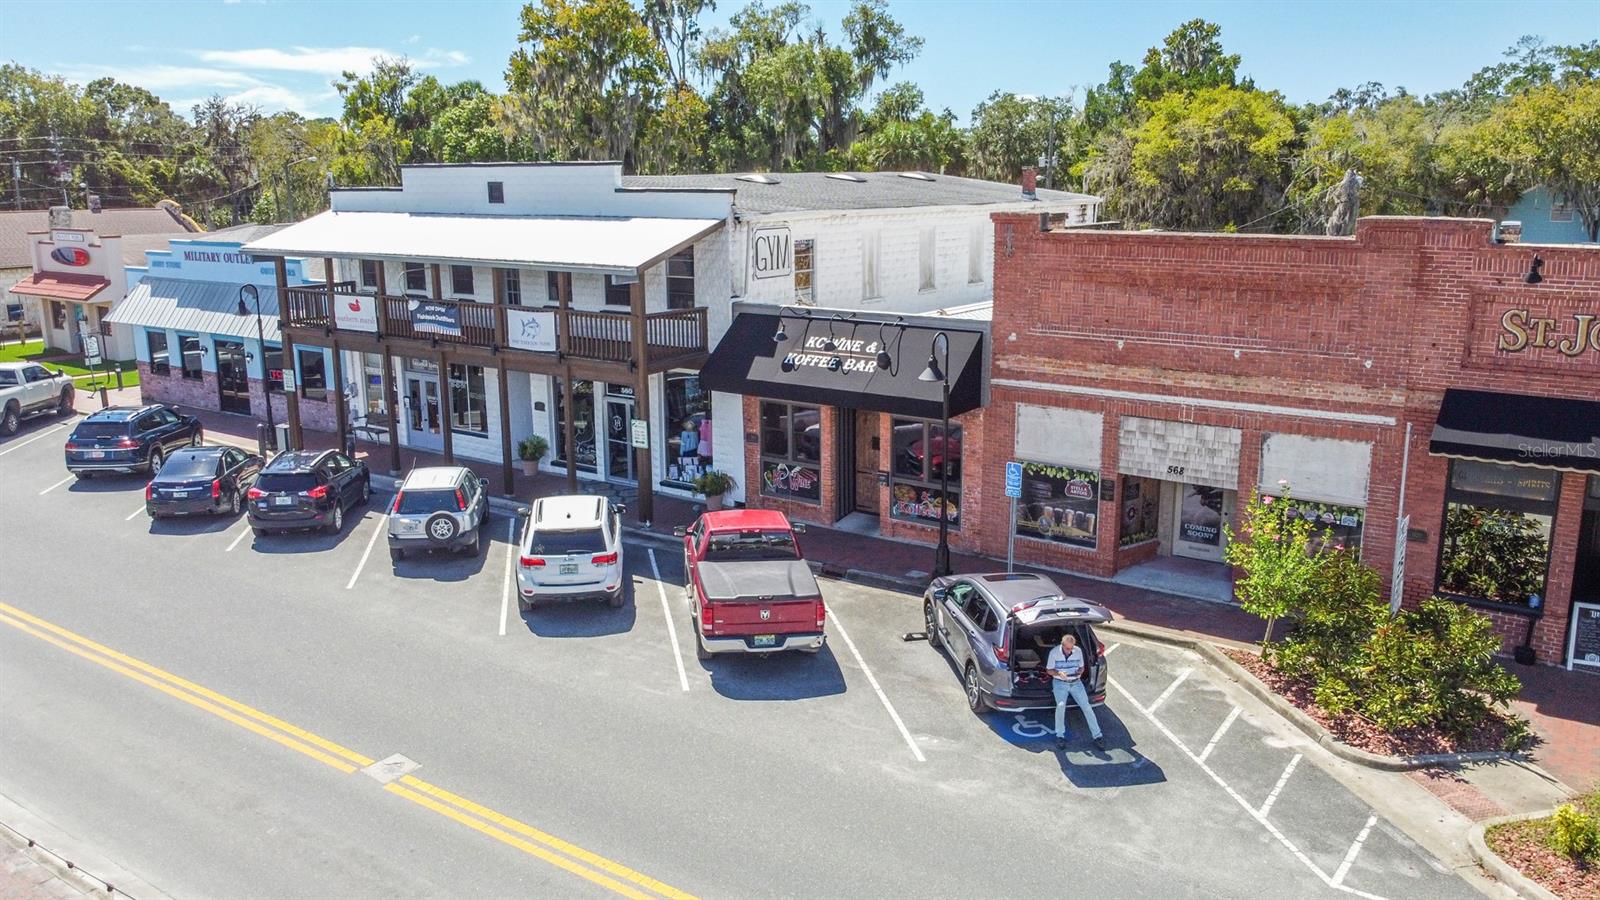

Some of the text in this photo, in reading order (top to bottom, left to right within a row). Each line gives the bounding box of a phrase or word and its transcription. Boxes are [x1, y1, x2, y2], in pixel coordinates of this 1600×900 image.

[183, 251, 221, 263] MILITARY
[755, 234, 790, 271] GYM
[831, 337, 864, 352] WINE
[866, 341, 878, 353] &
[784, 353, 878, 373] KOFFEE BAR
[621, 387, 633, 395] 560
[1167, 466, 1185, 475] 568
[1184, 523, 1217, 533] COMING
